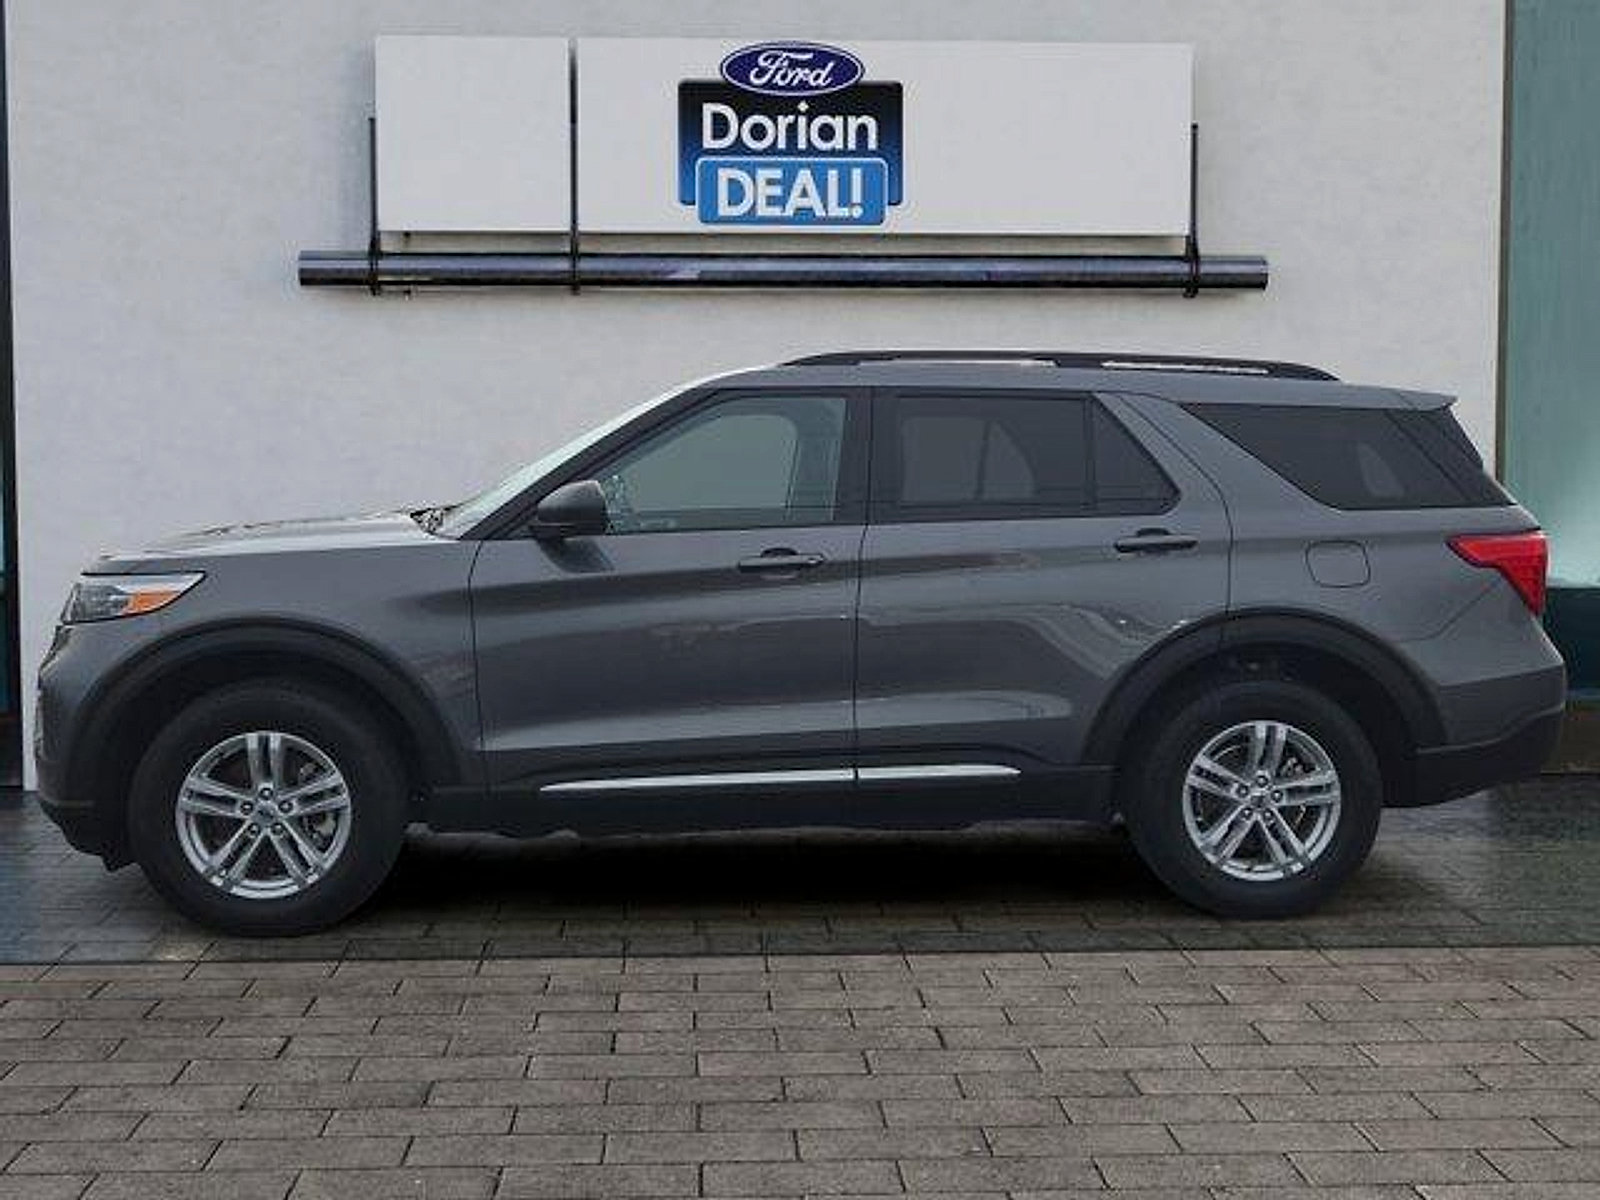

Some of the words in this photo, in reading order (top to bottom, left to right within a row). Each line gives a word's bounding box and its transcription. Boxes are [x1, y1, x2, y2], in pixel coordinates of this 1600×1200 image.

[749, 50, 835, 86] Ford
[702, 100, 878, 150] Dorian
[717, 167, 864, 218] DEAL!
